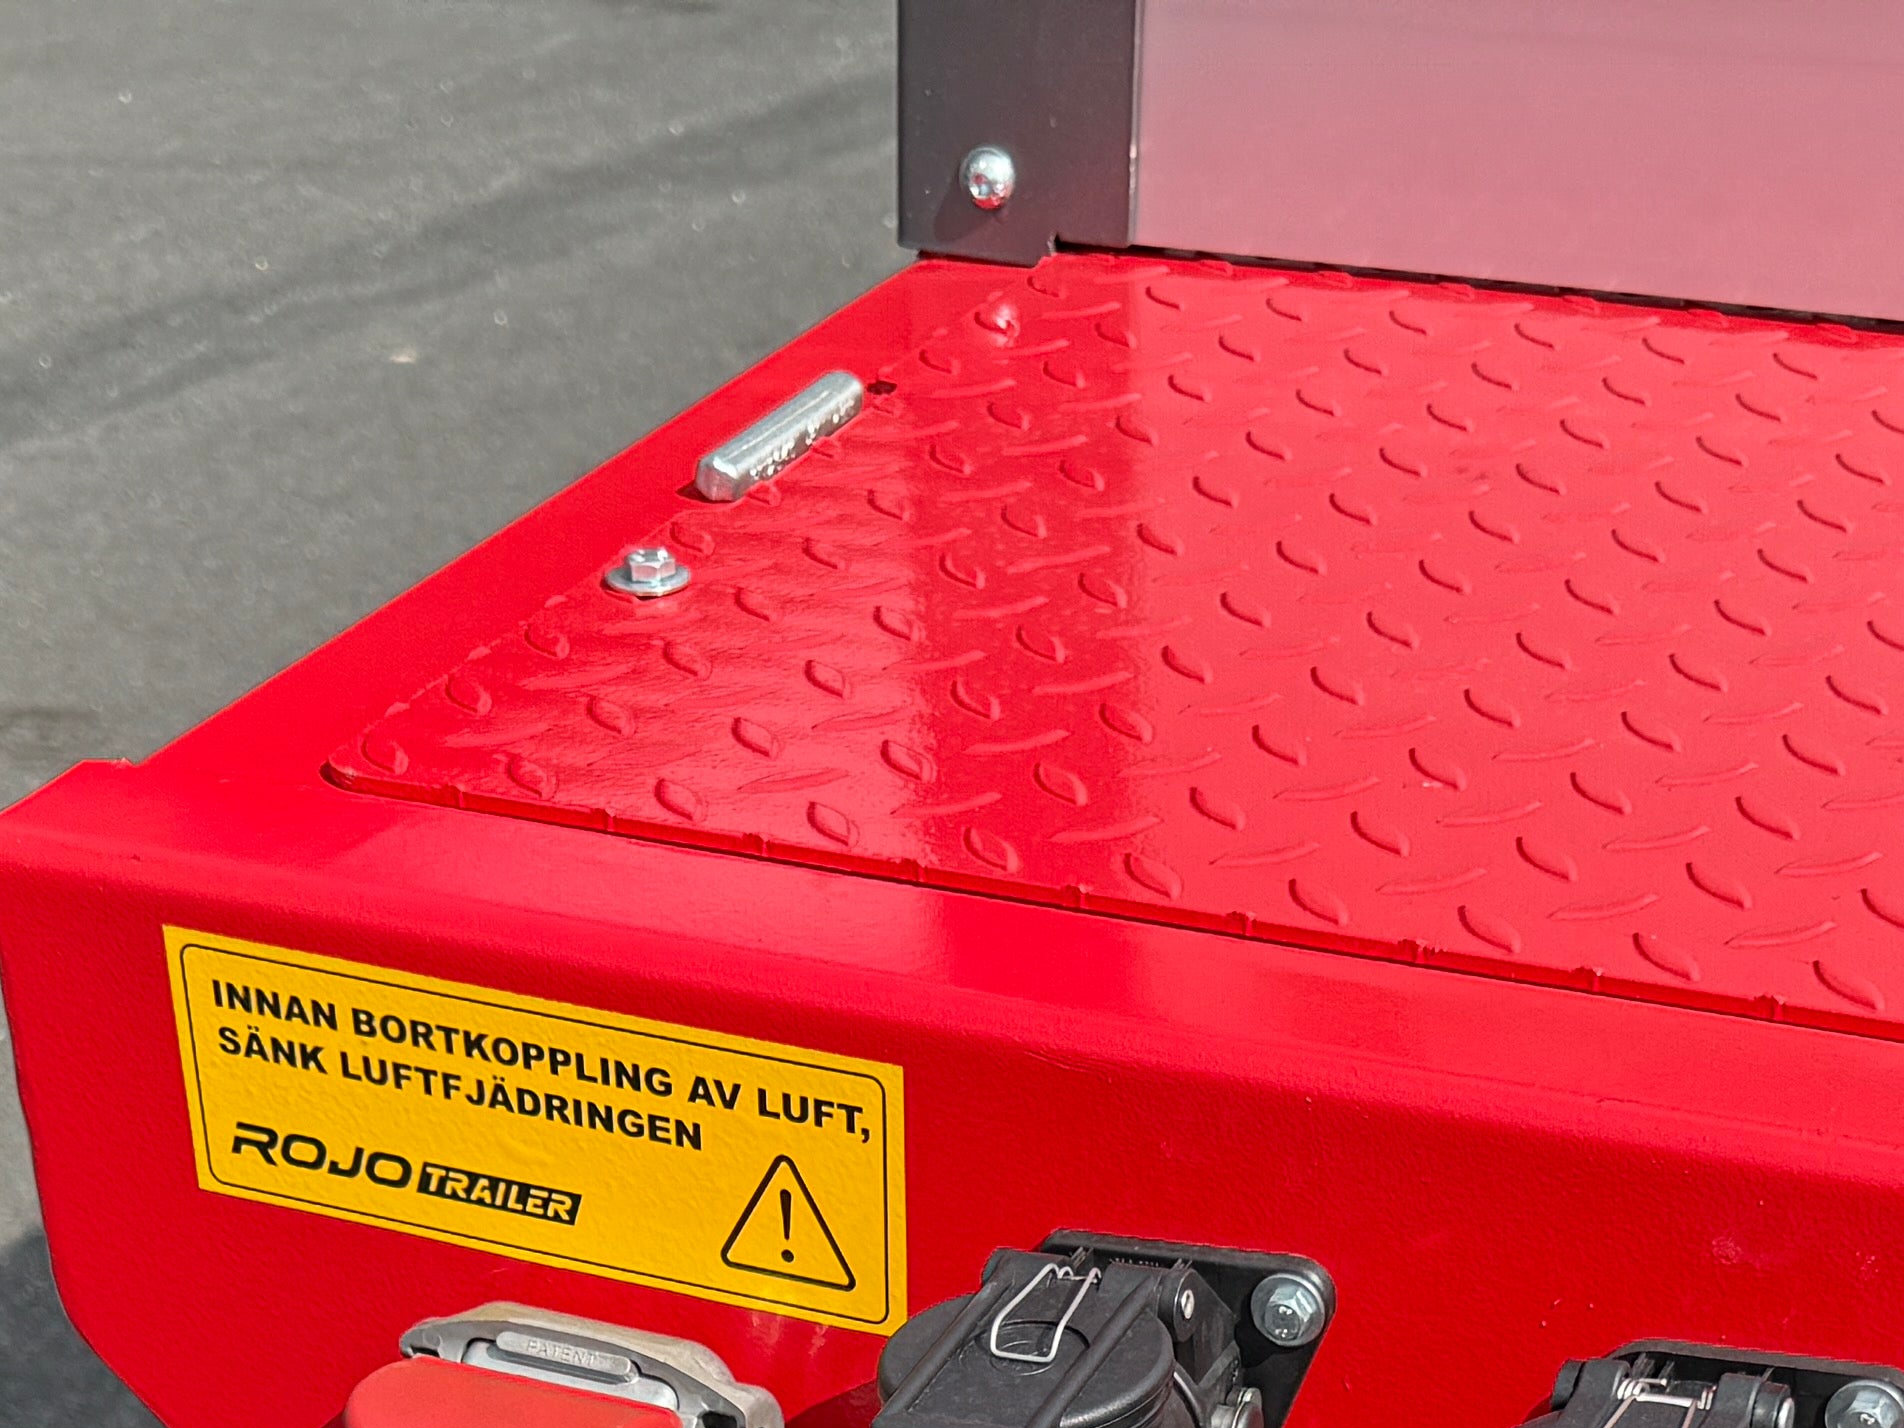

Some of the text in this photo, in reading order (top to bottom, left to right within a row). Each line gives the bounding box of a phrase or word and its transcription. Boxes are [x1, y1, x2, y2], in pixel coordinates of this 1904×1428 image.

[211, 979, 873, 1145] INNAN BORTKOPPLING AV LUFT,
[217, 1025, 703, 1152] SÄNK LUFTFJÄDRINGEN
[230, 1121, 578, 1223] ROJO TRAILER
[527, 1338, 596, 1367] PATENT
